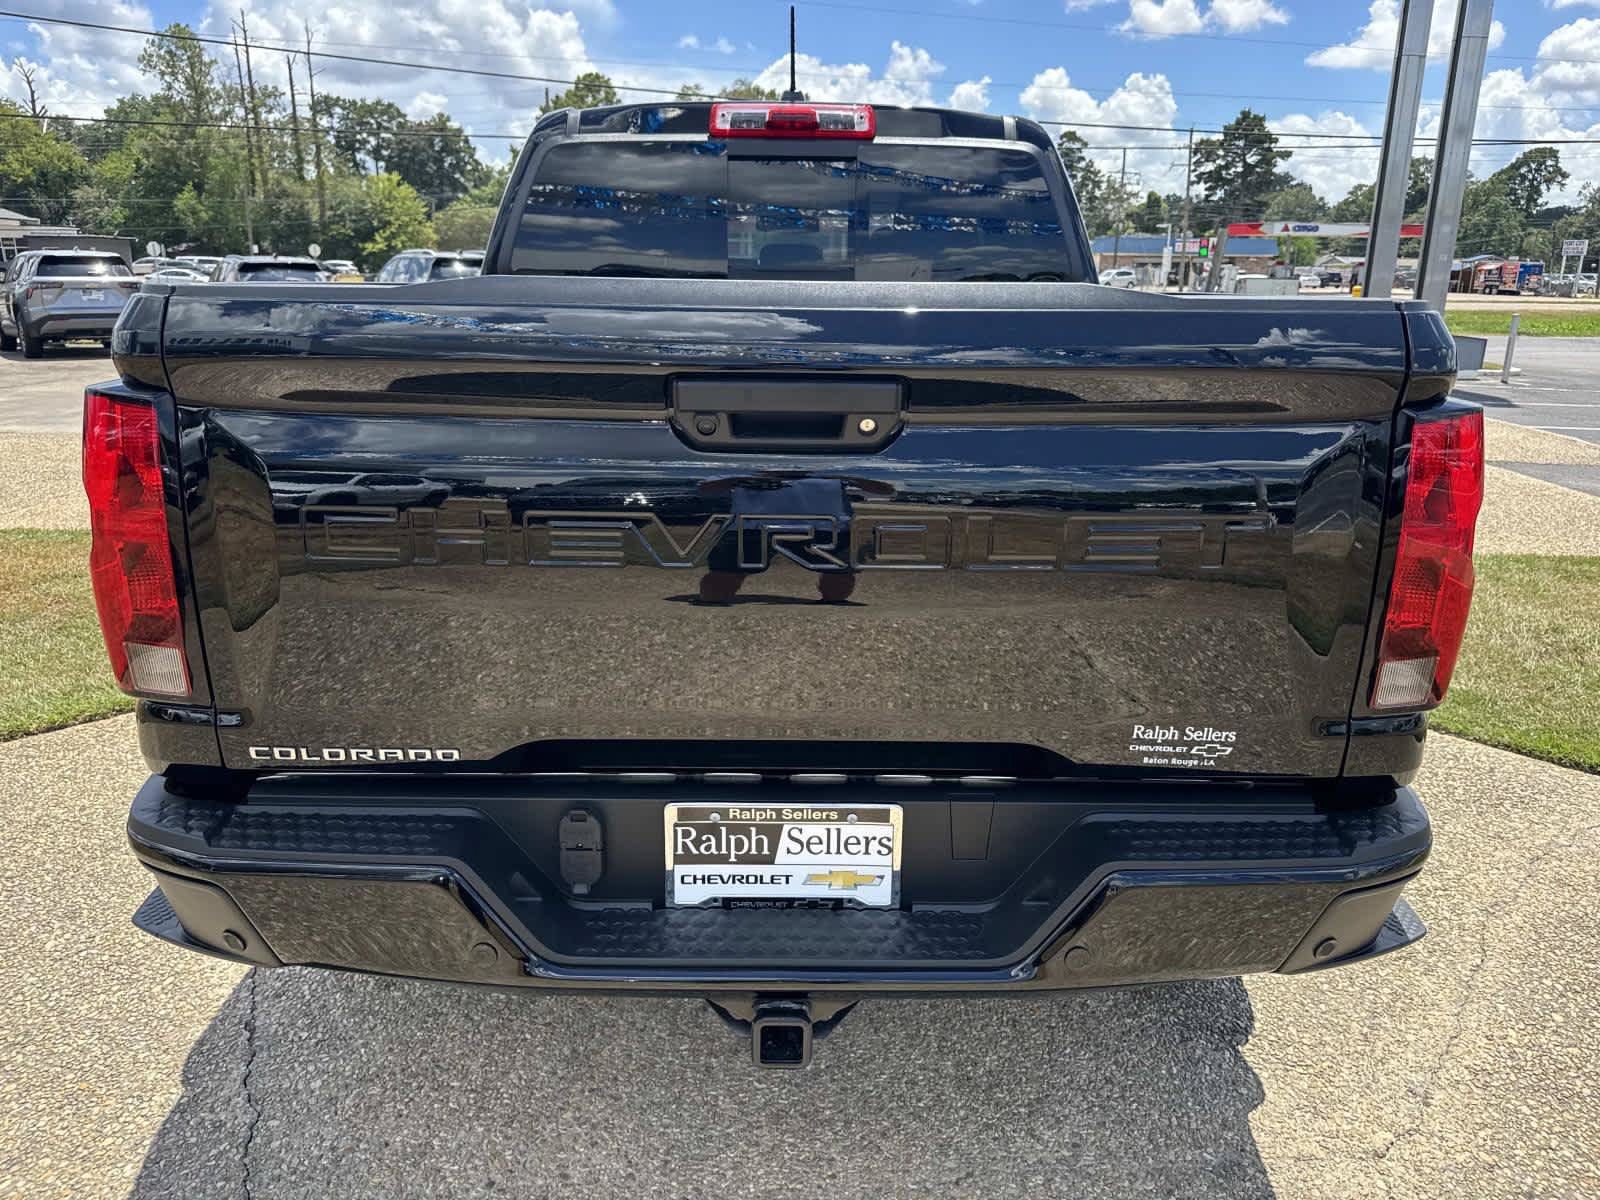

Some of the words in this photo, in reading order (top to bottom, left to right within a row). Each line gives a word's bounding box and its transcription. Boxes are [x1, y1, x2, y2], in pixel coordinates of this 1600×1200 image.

[301, 505, 1275, 569] CHEVROLET
[1132, 724, 1179, 743] Ralph
[1183, 726, 1237, 742] Sellers
[249, 746, 461, 762] COLORADO
[1143, 757, 1169, 765] Baton
[1171, 757, 1199, 767] Rouge
[728, 807, 777, 821] Ralph
[781, 808, 839, 820] Sellers
[674, 826, 771, 862] Ralph
[786, 826, 893, 856] Sellers
[680, 874, 794, 885] CHEVROLET
